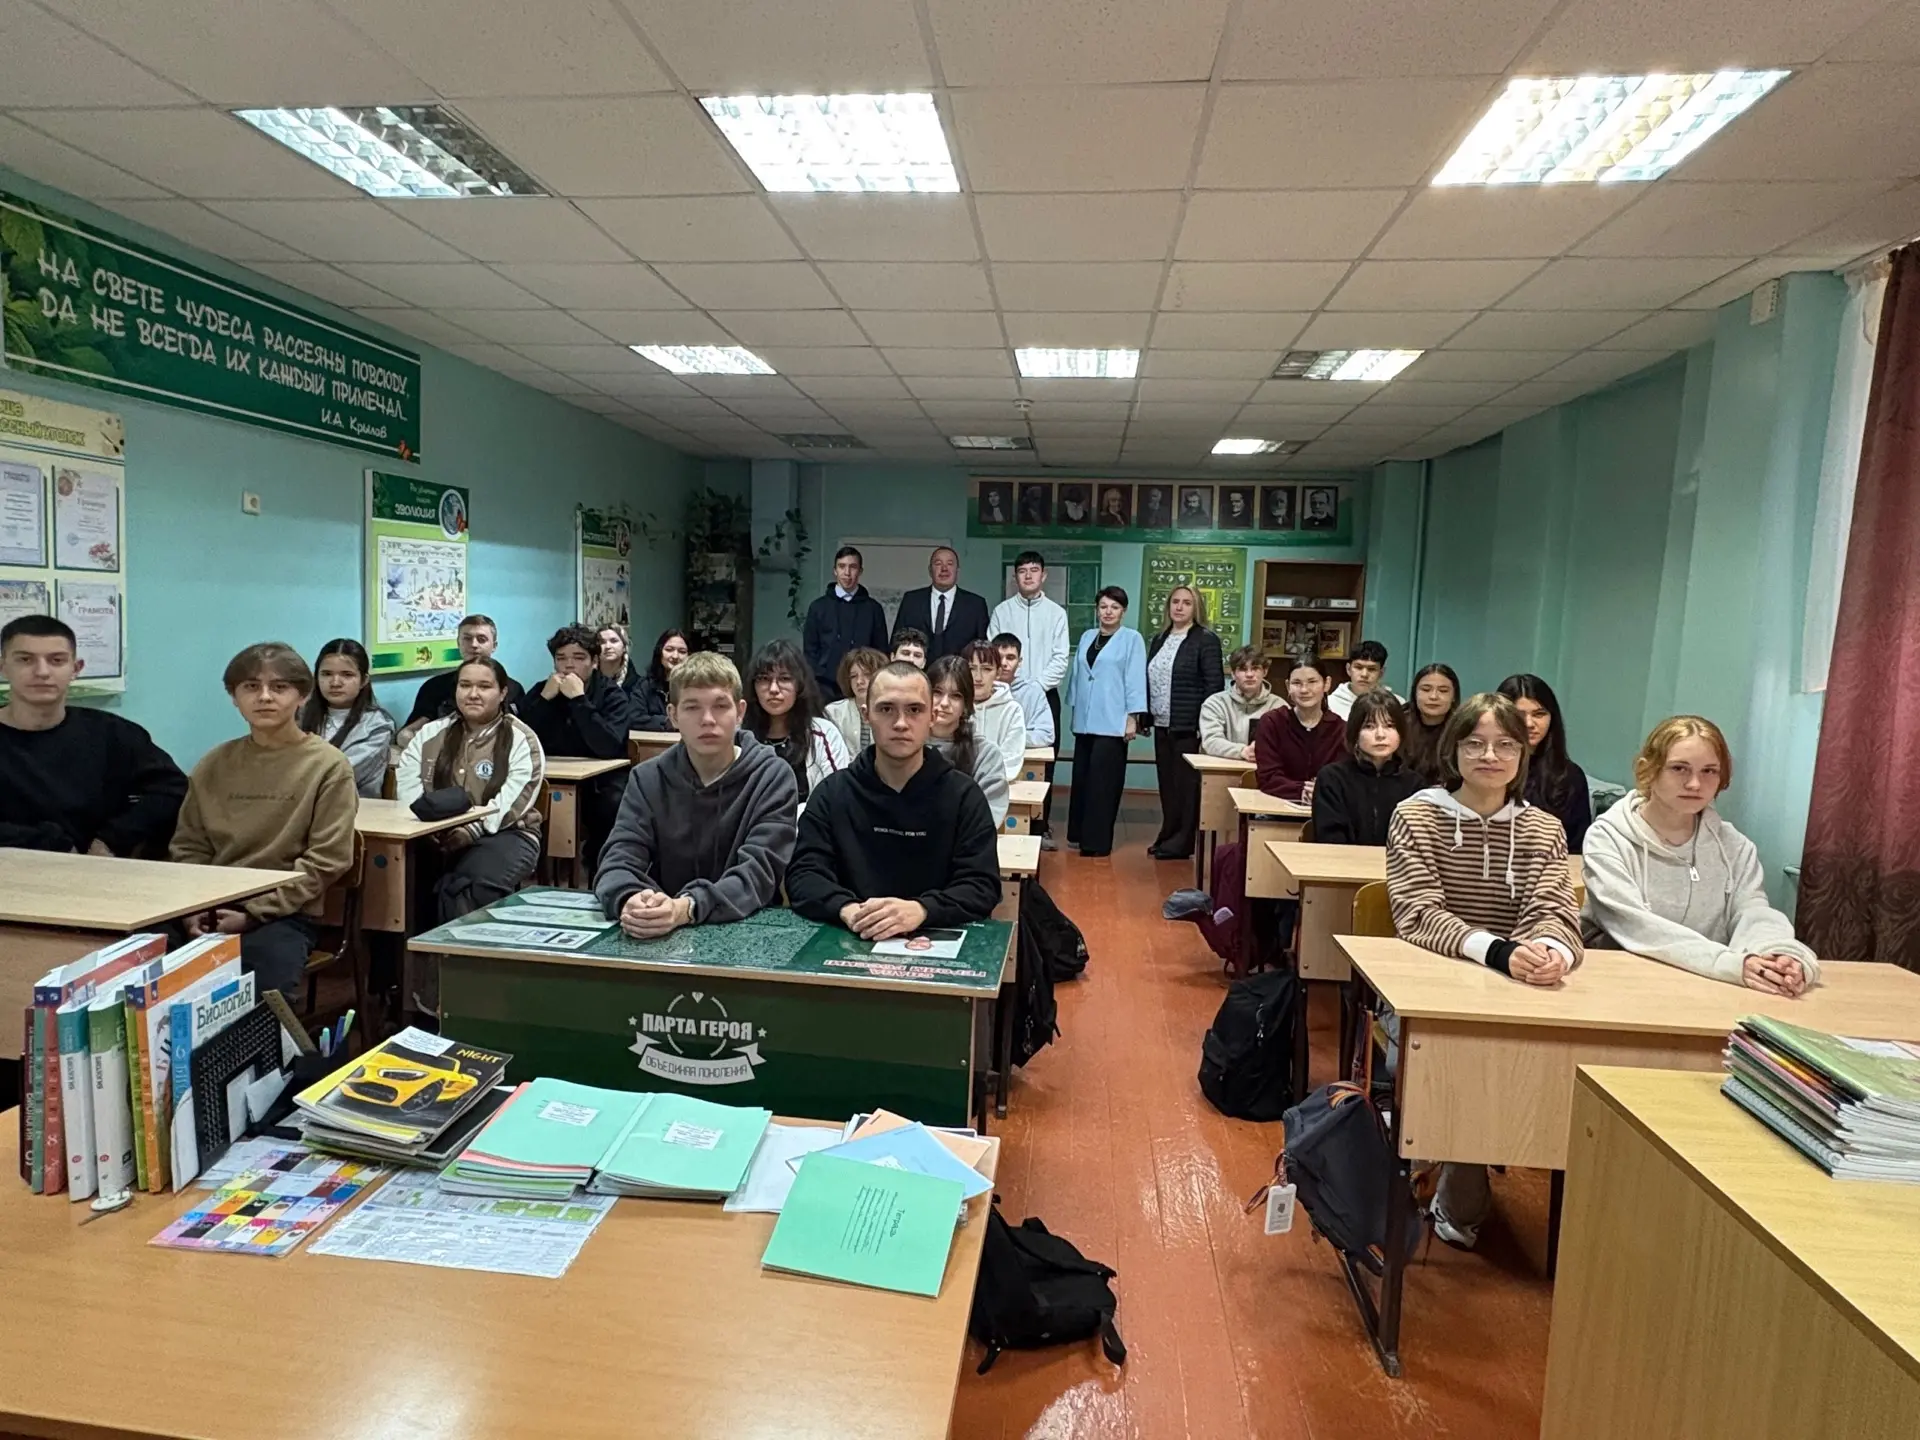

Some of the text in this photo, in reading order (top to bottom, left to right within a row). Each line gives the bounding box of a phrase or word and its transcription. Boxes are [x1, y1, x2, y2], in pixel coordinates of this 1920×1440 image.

[37, 248, 81, 288] НА
[92, 268, 166, 315] СВЕТЕ
[176, 295, 256, 347] ЧУДЕСА
[262, 326, 347, 376] РАССЕЯНЫ
[38, 286, 78, 325] ДА
[90, 303, 126, 337] НЕ
[136, 317, 217, 366] ВСЕГДА
[225, 345, 251, 375] ИХ
[258, 356, 326, 397] КАЖДЫЙ
[349, 415, 388, 439] Крылов
[642, 1012, 753, 1041] ПАРТА ГЕРОЯ
[456, 1048, 503, 1064] NIGHT
[645, 1055, 748, 1078] ОБЪЕДИНЯЯ ПОКОЛЕНИЯ
